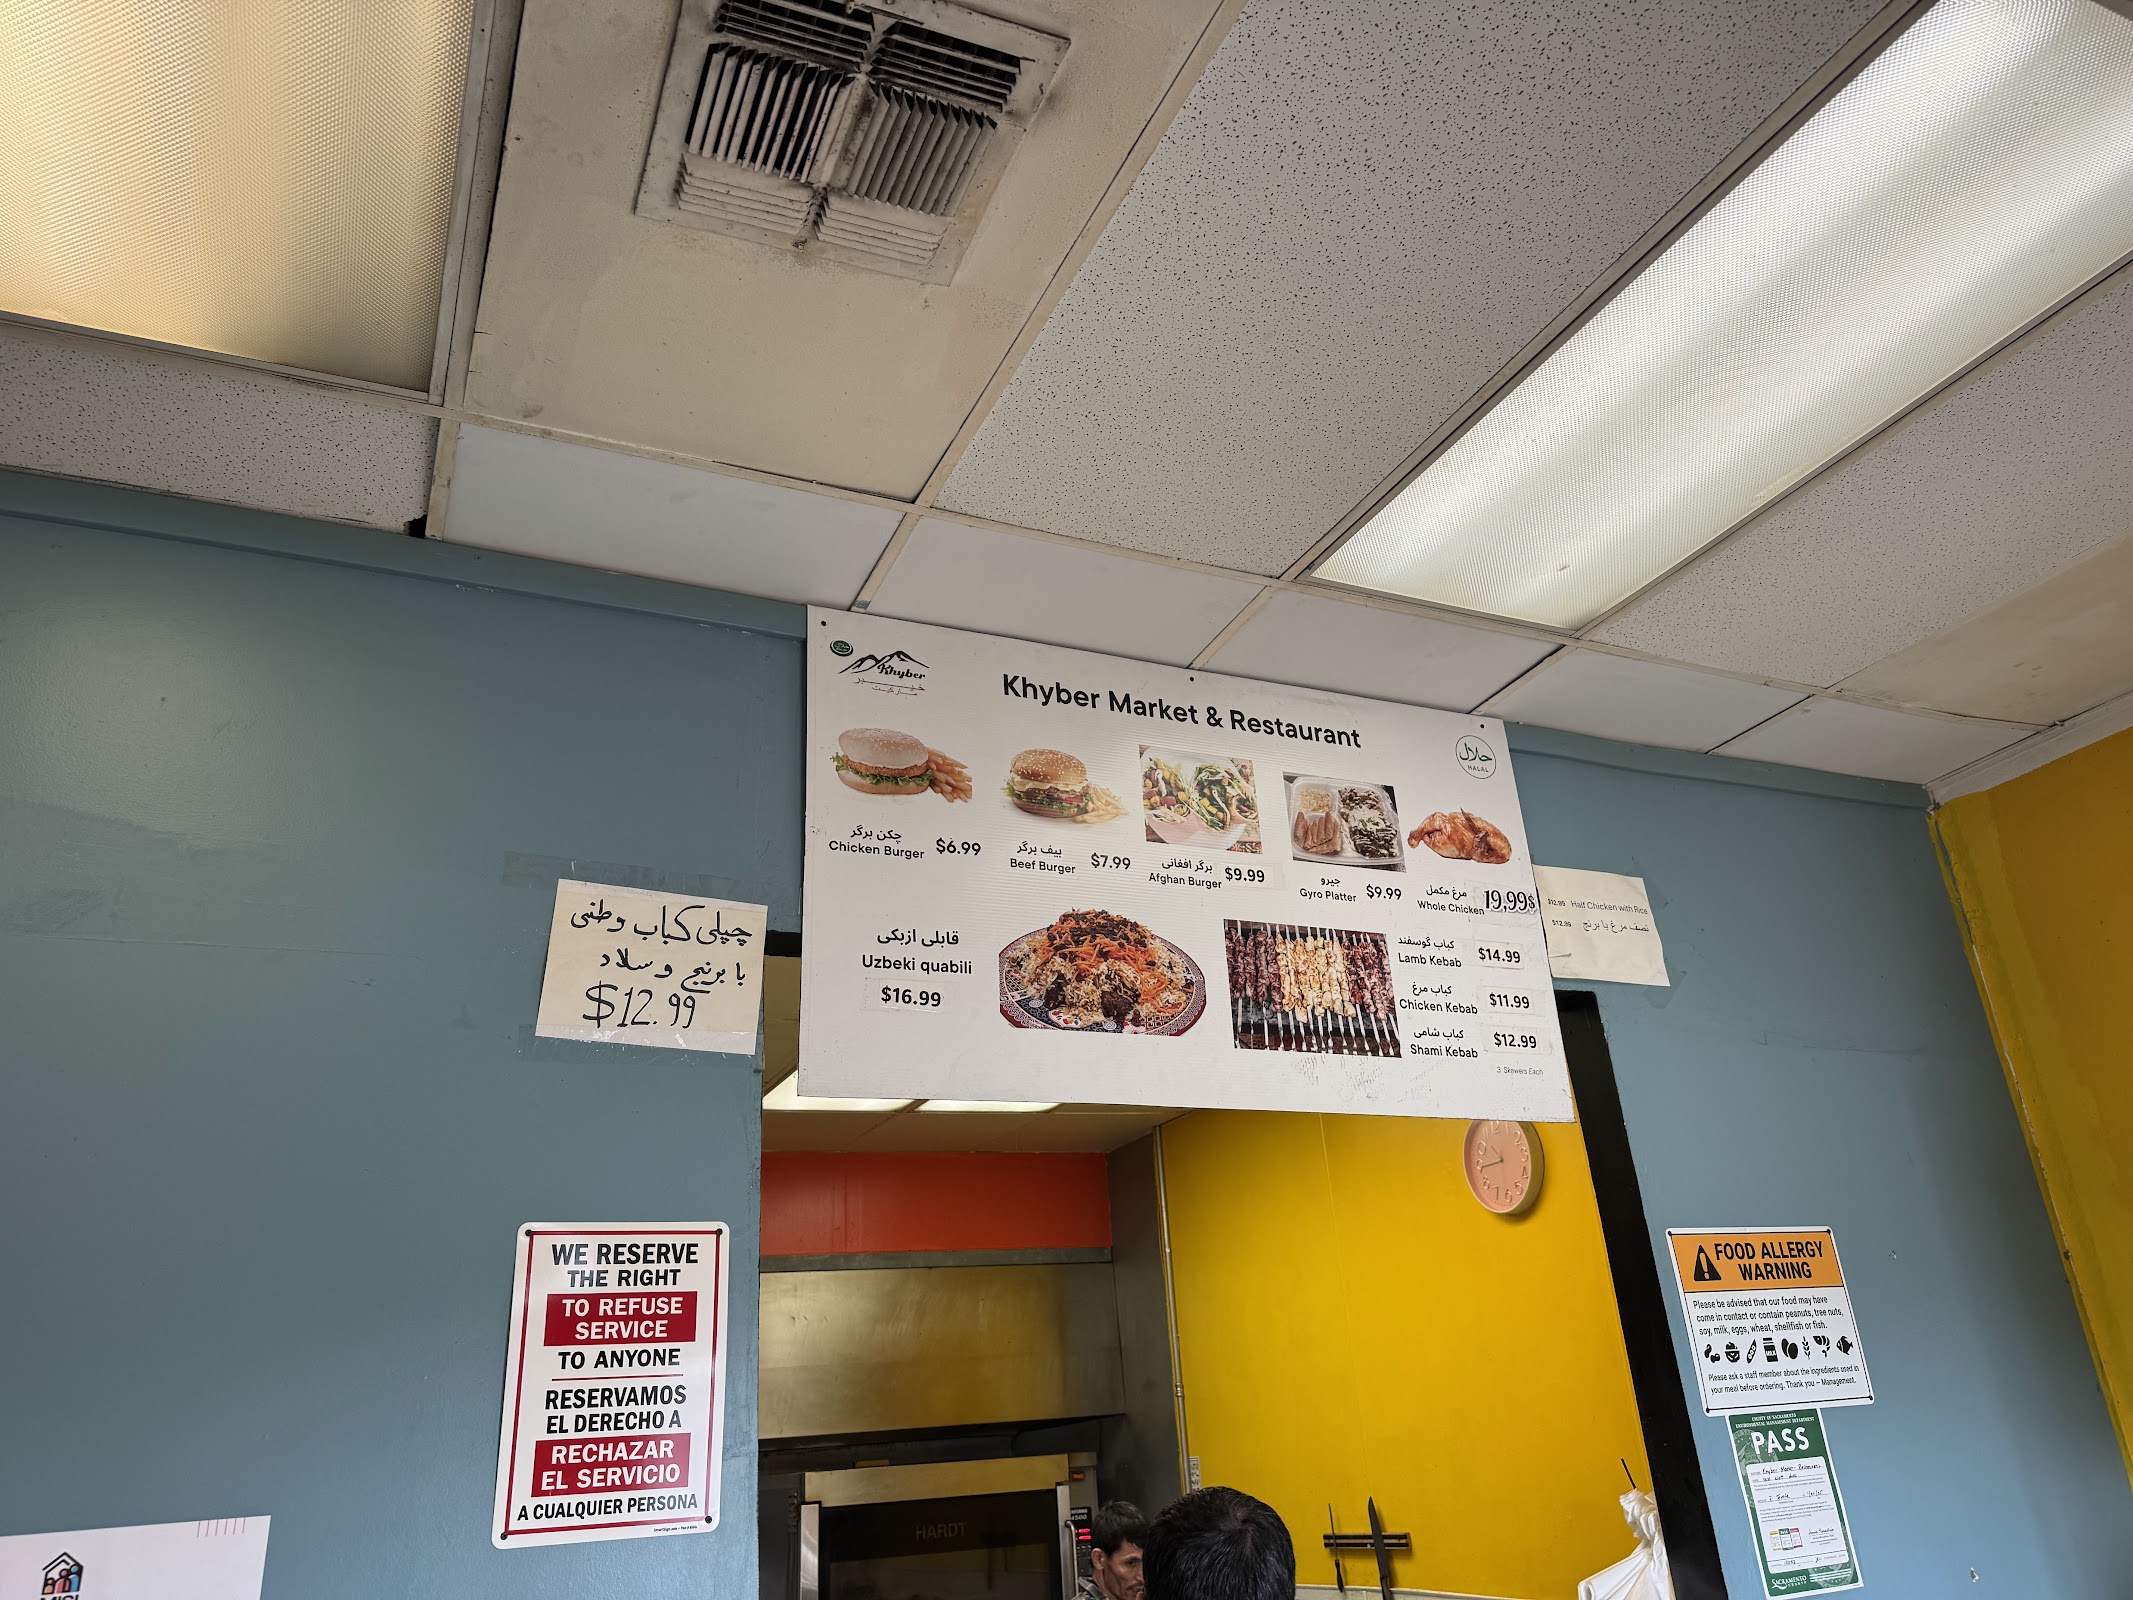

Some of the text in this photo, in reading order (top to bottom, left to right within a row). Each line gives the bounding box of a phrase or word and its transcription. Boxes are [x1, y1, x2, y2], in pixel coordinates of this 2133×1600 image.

[877, 664, 926, 679] Khyber
[1003, 673, 1361, 748] Khyber Market & Restaurant
[1459, 742, 1492, 762] حلال
[850, 825, 902, 843] چکن برگر
[829, 840, 924, 860] Chicken Burger
[936, 838, 981, 856] $6.99
[1017, 841, 1037, 856] برگر
[1010, 858, 1076, 875] Beef Burger
[1091, 852, 1131, 870] $7.99
[1161, 858, 1213, 874] برگر افغانی
[1149, 872, 1222, 890] Afghan Burger
[1225, 866, 1265, 883] $9.99
[1300, 888, 1357, 902] Gyro Platter
[1366, 883, 1402, 901] $9.99
[1426, 885, 1467, 900] مرغ مکمل
[1417, 900, 1485, 915] Whole Chicken
[1484, 889, 1536, 913] 19,99$
[1571, 900, 1586, 909] Half
[1587, 901, 1618, 911] Chicken
[1618, 904, 1633, 912] with
[1634, 905, 1648, 914] Rice
[633, 905, 705, 945] کباب
[877, 928, 959, 948] قابلی ازبکی
[1398, 936, 1455, 951] کباب گوسفند
[1398, 953, 1462, 968] Lamb Kebab
[1478, 947, 1521, 964] $14.99
[599, 947, 746, 994] با برنج و سلاد
[862, 954, 972, 975] Uzbeki quabili
[881, 985, 941, 1007] $16.99
[1412, 982, 1452, 997] کباب مرغ
[1399, 999, 1478, 1015] Chicken Kebab
[1489, 993, 1530, 1009] $11.99
[1413, 1027, 1464, 1041] کباب شامی
[1493, 1032, 1537, 1049] $12.99
[1410, 1044, 1478, 1058] Shami Kebab
[1504, 1066, 1544, 1076] Skewers Each
[1513, 1130, 1521, 1145] 2
[1520, 1146, 1528, 1162] 3
[1522, 1165, 1529, 1180] 4
[1483, 1175, 1490, 1190] 8
[1514, 1180, 1524, 1196] 5
[1492, 1185, 1499, 1201] 7
[1505, 1188, 1513, 1203] 6
[552, 1242, 699, 1266] WE RESERVE
[1714, 1241, 1823, 1261] FOOD ALLERGY
[567, 1268, 681, 1288] THE RIGHT
[1738, 1261, 1812, 1281] WARNING
[562, 1296, 683, 1317] TO REFUSE
[1693, 1300, 1716, 1309] Please
[1717, 1299, 1725, 1308] be
[1726, 1298, 1752, 1307] advised
[1753, 1298, 1767, 1306] that
[1781, 1296, 1797, 1305] food
[1798, 1297, 1812, 1306] may
[1812, 1295, 1828, 1304] have
[1697, 1307, 1844, 1322] come in contact or contain peanuts, tree nuts,
[574, 1319, 668, 1340] SERVICE
[1699, 1320, 1828, 1337] soy, milk, eggs, wheat, shellfish or fish.
[557, 1348, 681, 1370] TO ANYONE
[1708, 1373, 1727, 1382] Please
[1728, 1372, 1739, 1380] ask
[1744, 1370, 1758, 1379] staff
[1759, 1369, 1782, 1378] member
[1783, 1368, 1800, 1376] about
[1800, 1366, 1810, 1375] the
[1811, 1365, 1840, 1376] ingredients
[1840, 1364, 1853, 1373] used
[1853, 1364, 1859, 1372] in
[1710, 1376, 1856, 1395] your meal before ordering. Thank you Management.
[545, 1384, 687, 1410] RESERVAMOS
[546, 1409, 682, 1434] EL DERECHO A
[1751, 1427, 1809, 1454] PASS
[551, 1439, 674, 1465] RECHAZAR
[541, 1463, 681, 1490] EL SERVICIO
[517, 1493, 698, 1521] A CUALQUIER PERSONA
[915, 1521, 968, 1541] HARDT
[1771, 1575, 1807, 1590] SACRAMENTO
